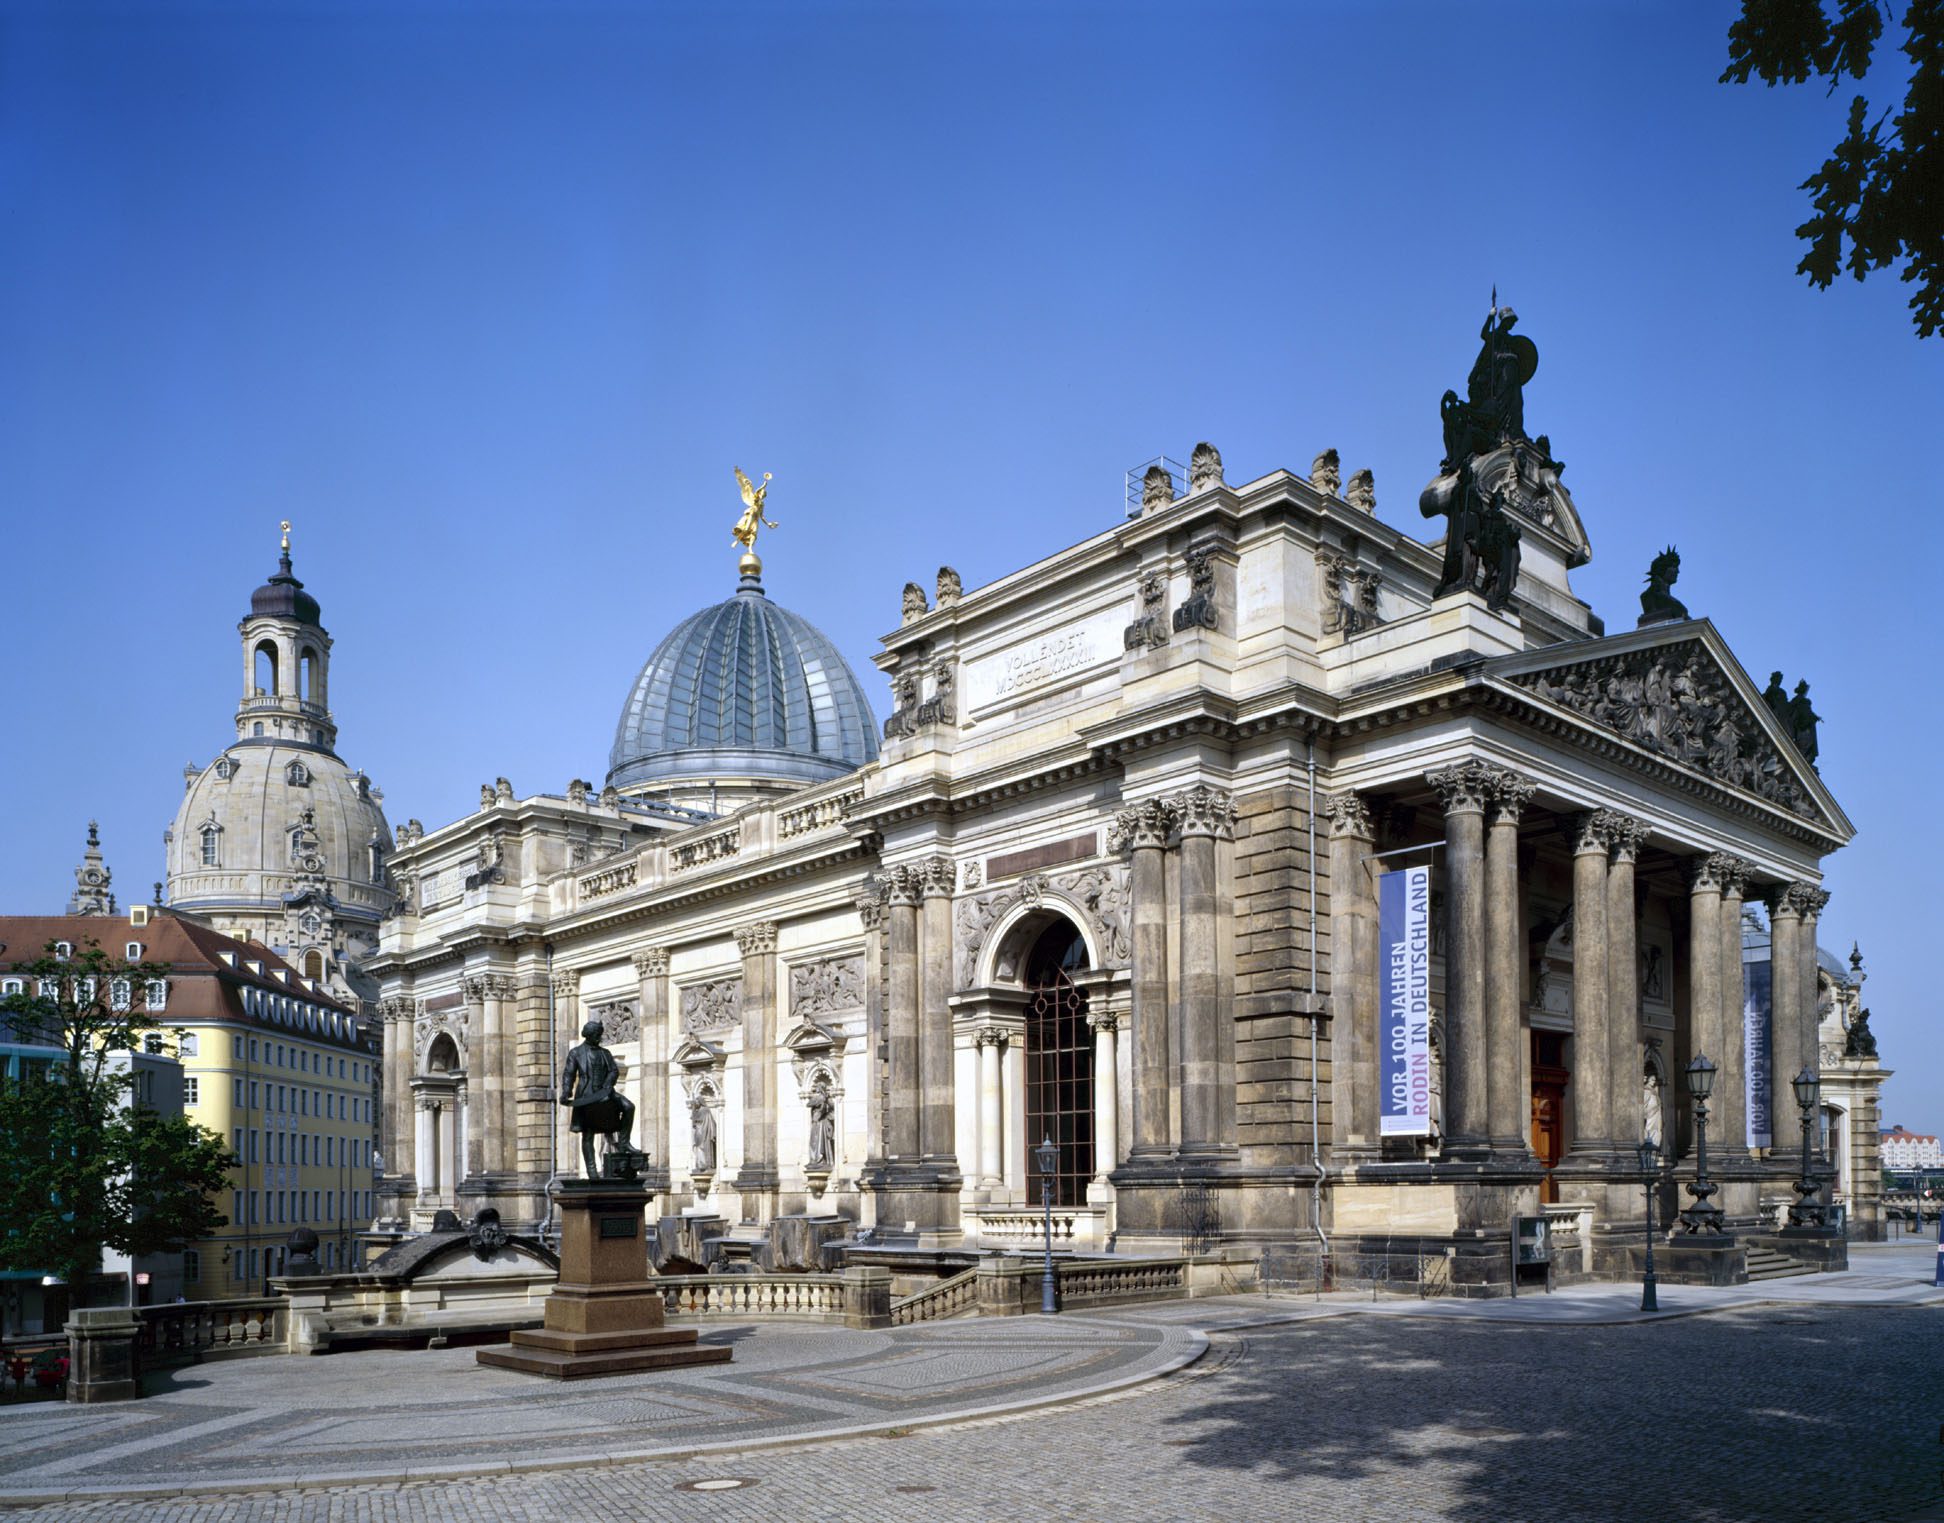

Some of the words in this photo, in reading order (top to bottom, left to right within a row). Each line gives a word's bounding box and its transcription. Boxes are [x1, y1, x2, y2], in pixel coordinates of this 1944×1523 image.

[1007, 632, 1085, 673] VOLLENDET
[1411, 872, 1427, 1013] DEUTSCHLAND
[1391, 942, 1406, 1018] JAHREN
[1391, 1025, 1406, 1063] 100
[1411, 1023, 1427, 1045] IN
[1392, 1072, 1407, 1111] VOR
[1412, 1054, 1428, 1116] RODIN
